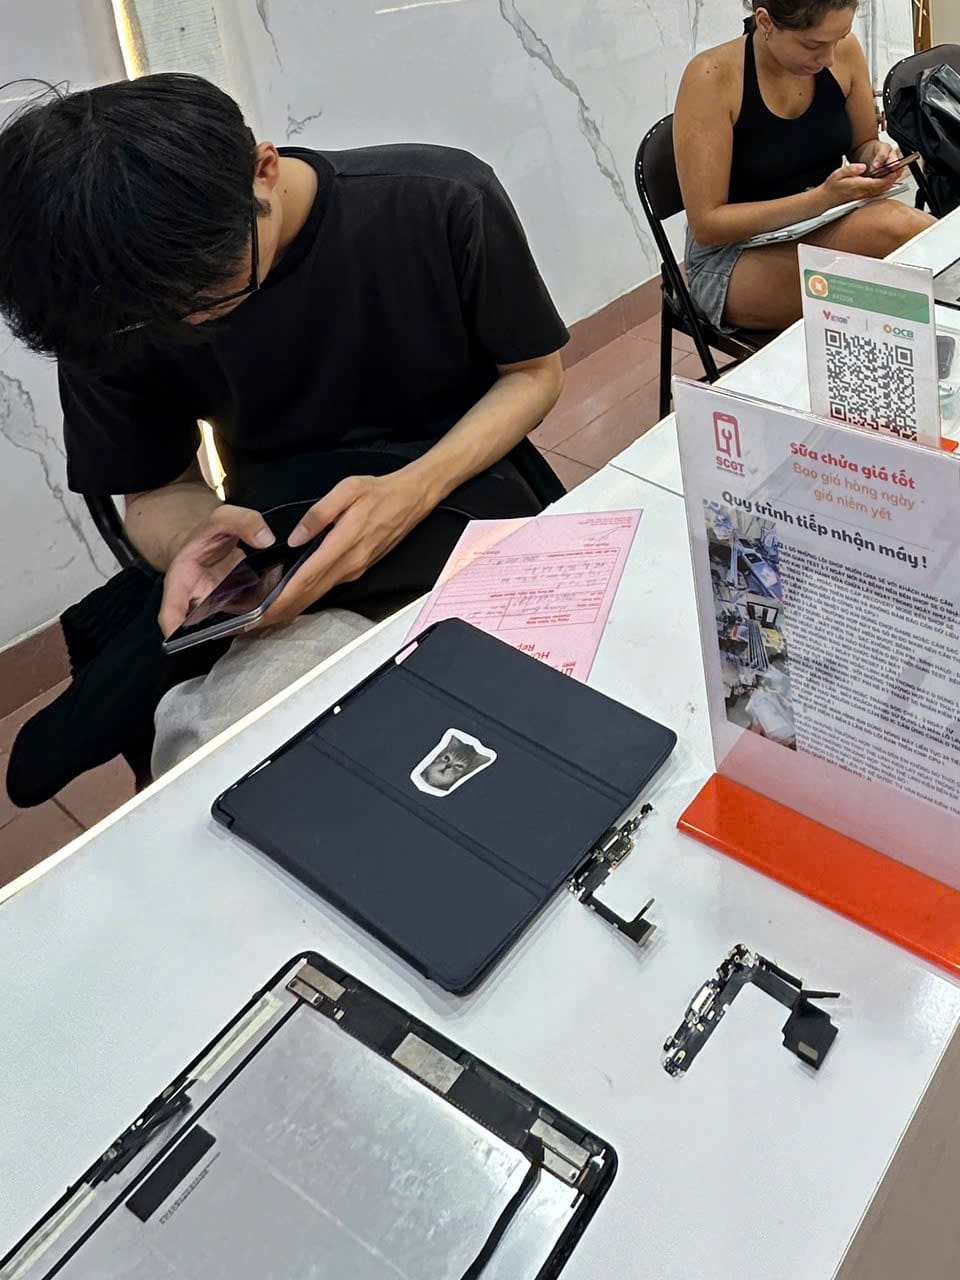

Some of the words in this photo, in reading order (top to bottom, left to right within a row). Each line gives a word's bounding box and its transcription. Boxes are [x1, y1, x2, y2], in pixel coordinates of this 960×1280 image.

[893, 327, 914, 338] OCB
[716, 455, 745, 473] SCGT
[861, 464, 889, 481] giá
[891, 469, 916, 489] tốt
[722, 490, 752, 513] Quy
[754, 502, 794, 525] trình
[797, 514, 828, 537] tiếp
[831, 527, 875, 552] nhận
[878, 546, 919, 568] máy
